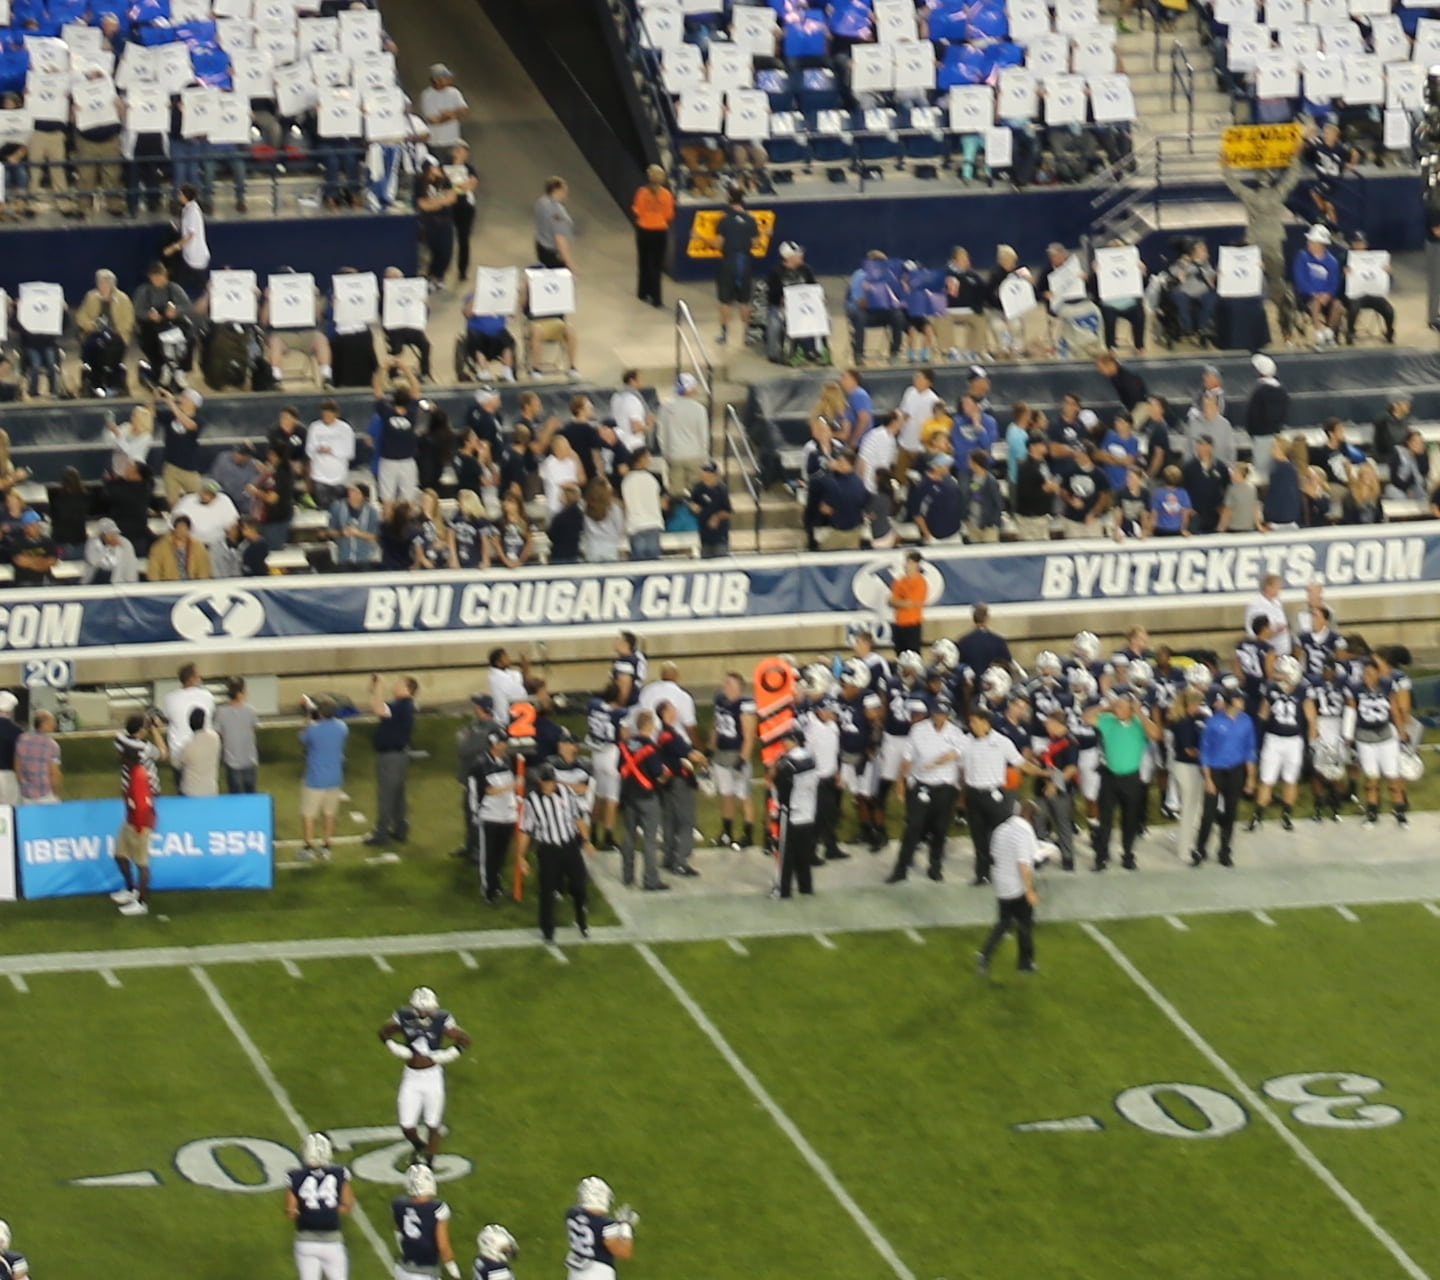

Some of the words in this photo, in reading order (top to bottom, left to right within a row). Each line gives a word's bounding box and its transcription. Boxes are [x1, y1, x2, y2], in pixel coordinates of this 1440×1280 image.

[1040, 537, 1426, 599] BYUTICKETS.COM
[364, 584, 454, 631] BYU
[459, 577, 634, 626] COUGAR
[640, 569, 751, 619] CLUB
[24, 659, 70, 687] 20
[508, 702, 537, 737] 2
[24, 836, 101, 865] IBEW
[106, 830, 205, 859] LCAL
[208, 827, 268, 857] 354
[1111, 1068, 1407, 1140] 30
[172, 1120, 476, 1194] 20
[298, 1173, 339, 1210] 44
